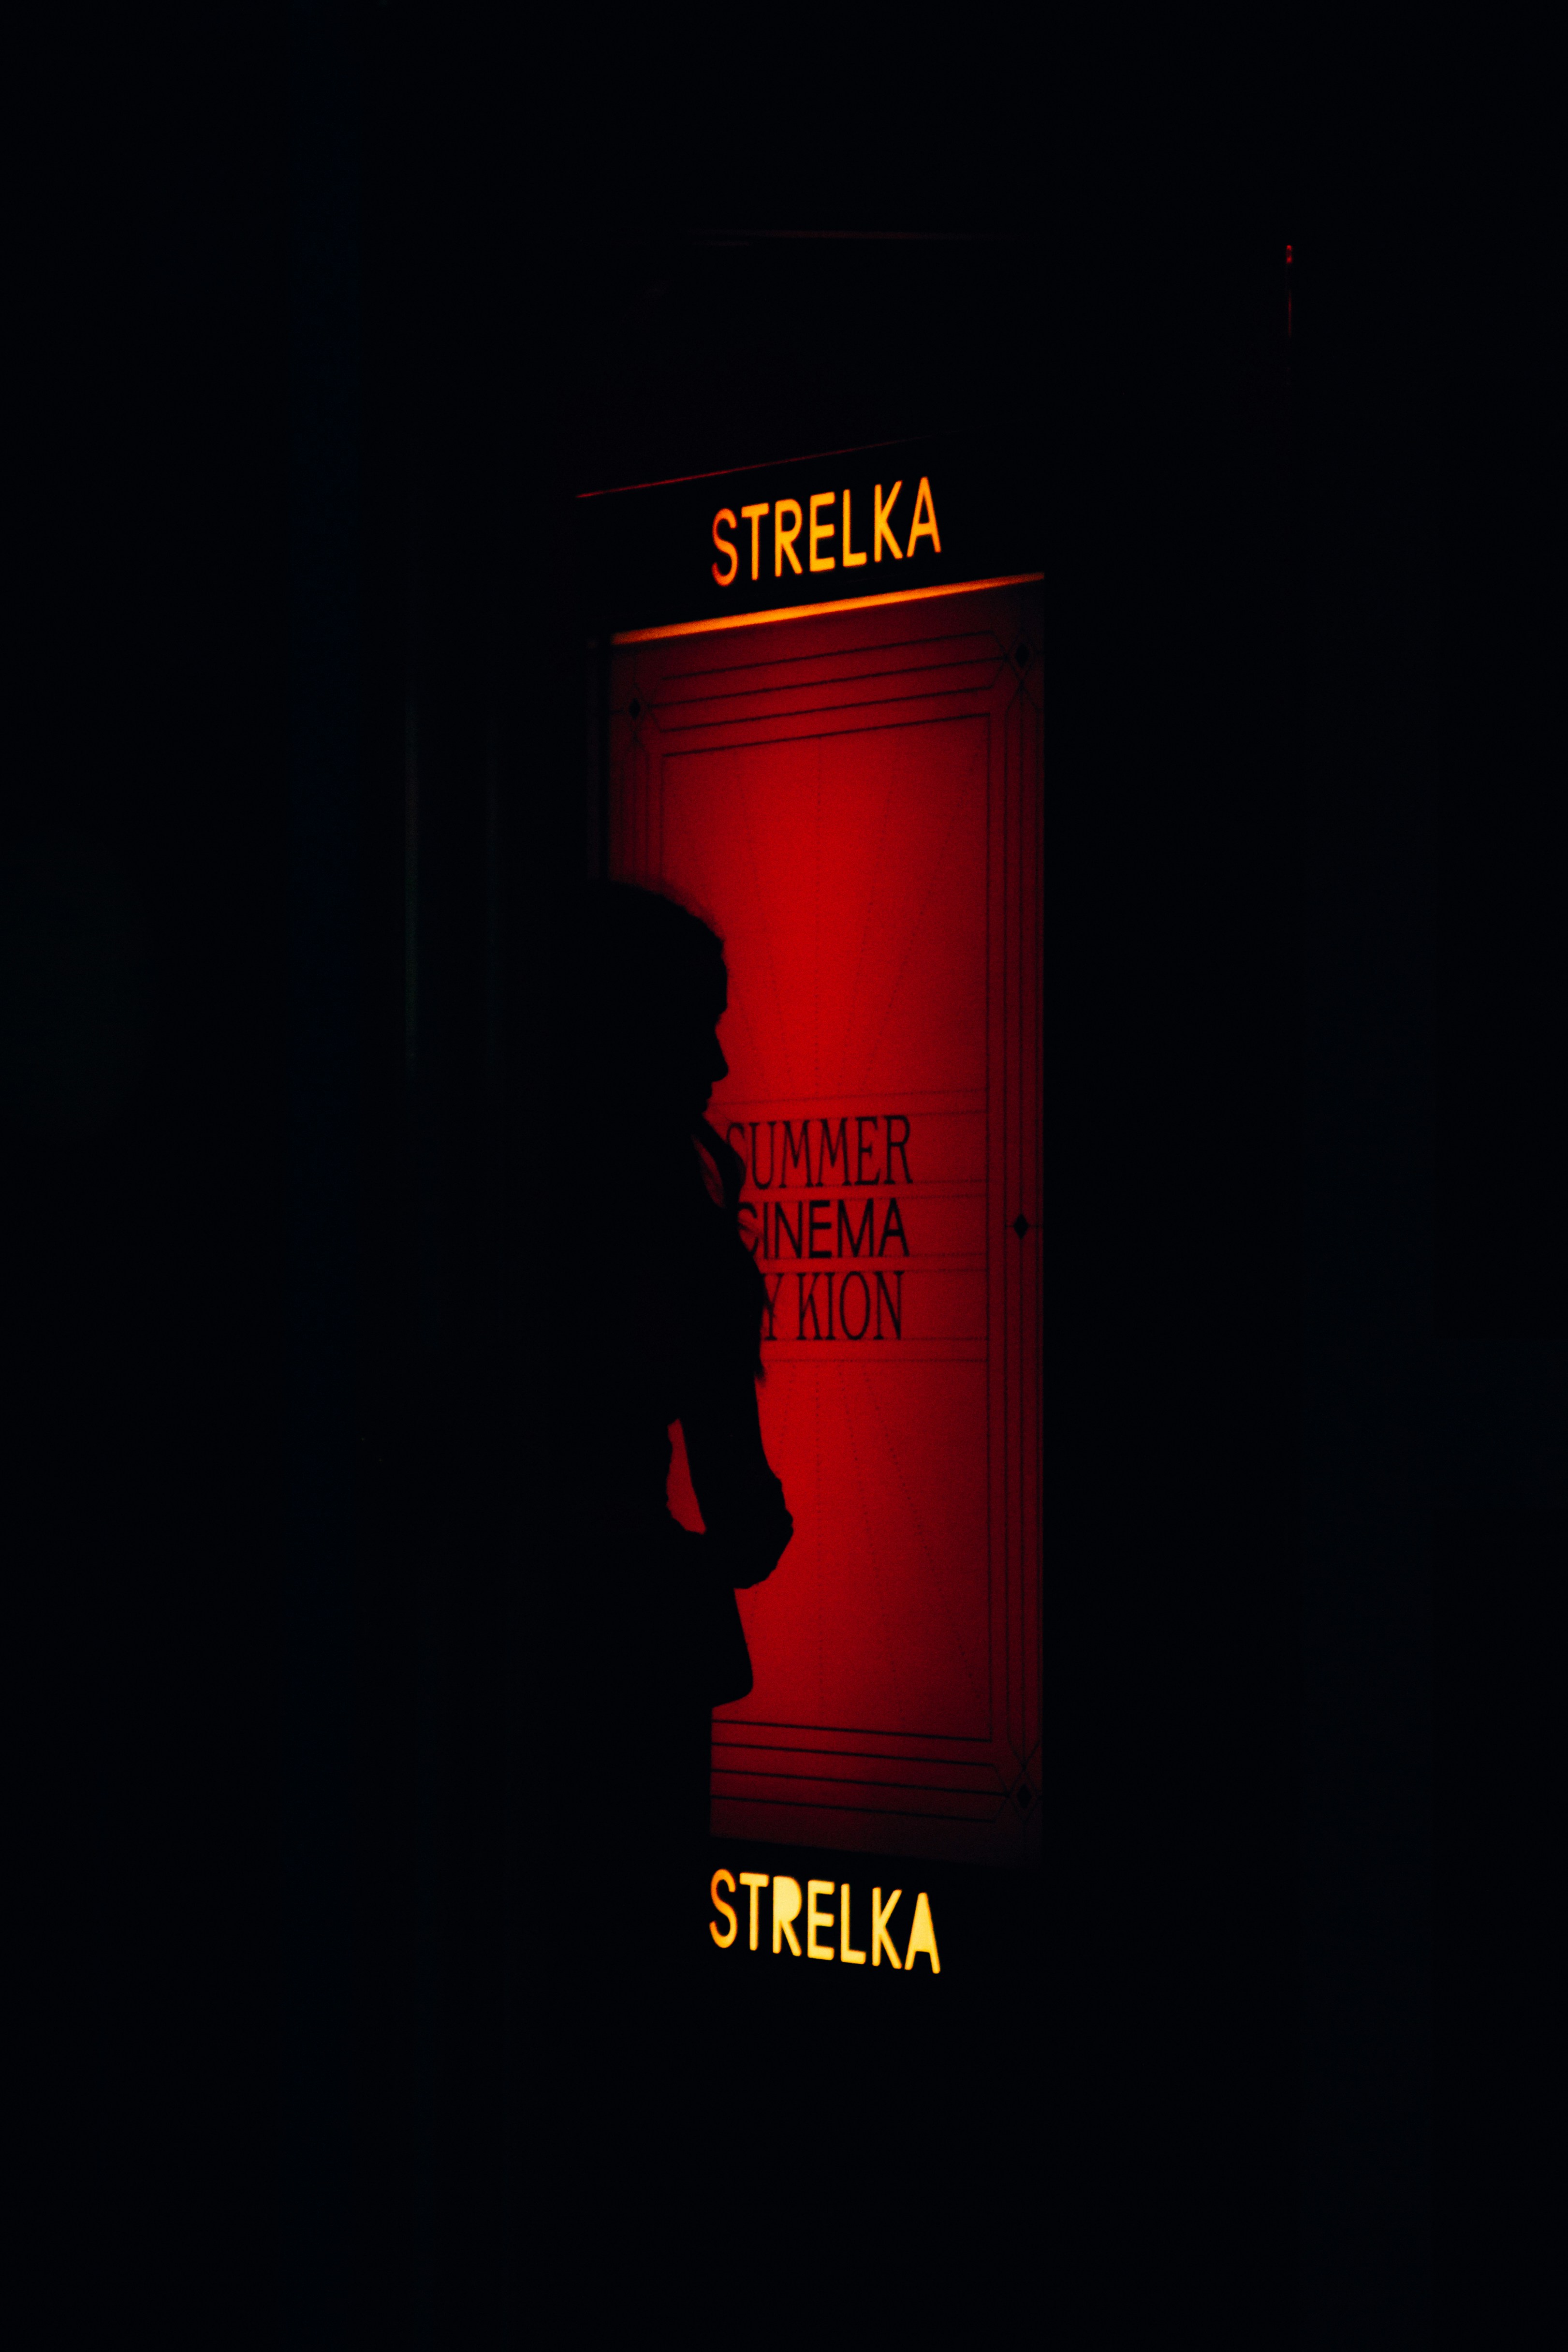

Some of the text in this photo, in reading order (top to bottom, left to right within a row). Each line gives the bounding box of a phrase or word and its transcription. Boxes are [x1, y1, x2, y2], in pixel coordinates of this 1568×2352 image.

[711, 476, 942, 587] STRELKA
[796, 1270, 905, 1341] KION
[709, 1868, 941, 1975] STRELKA
